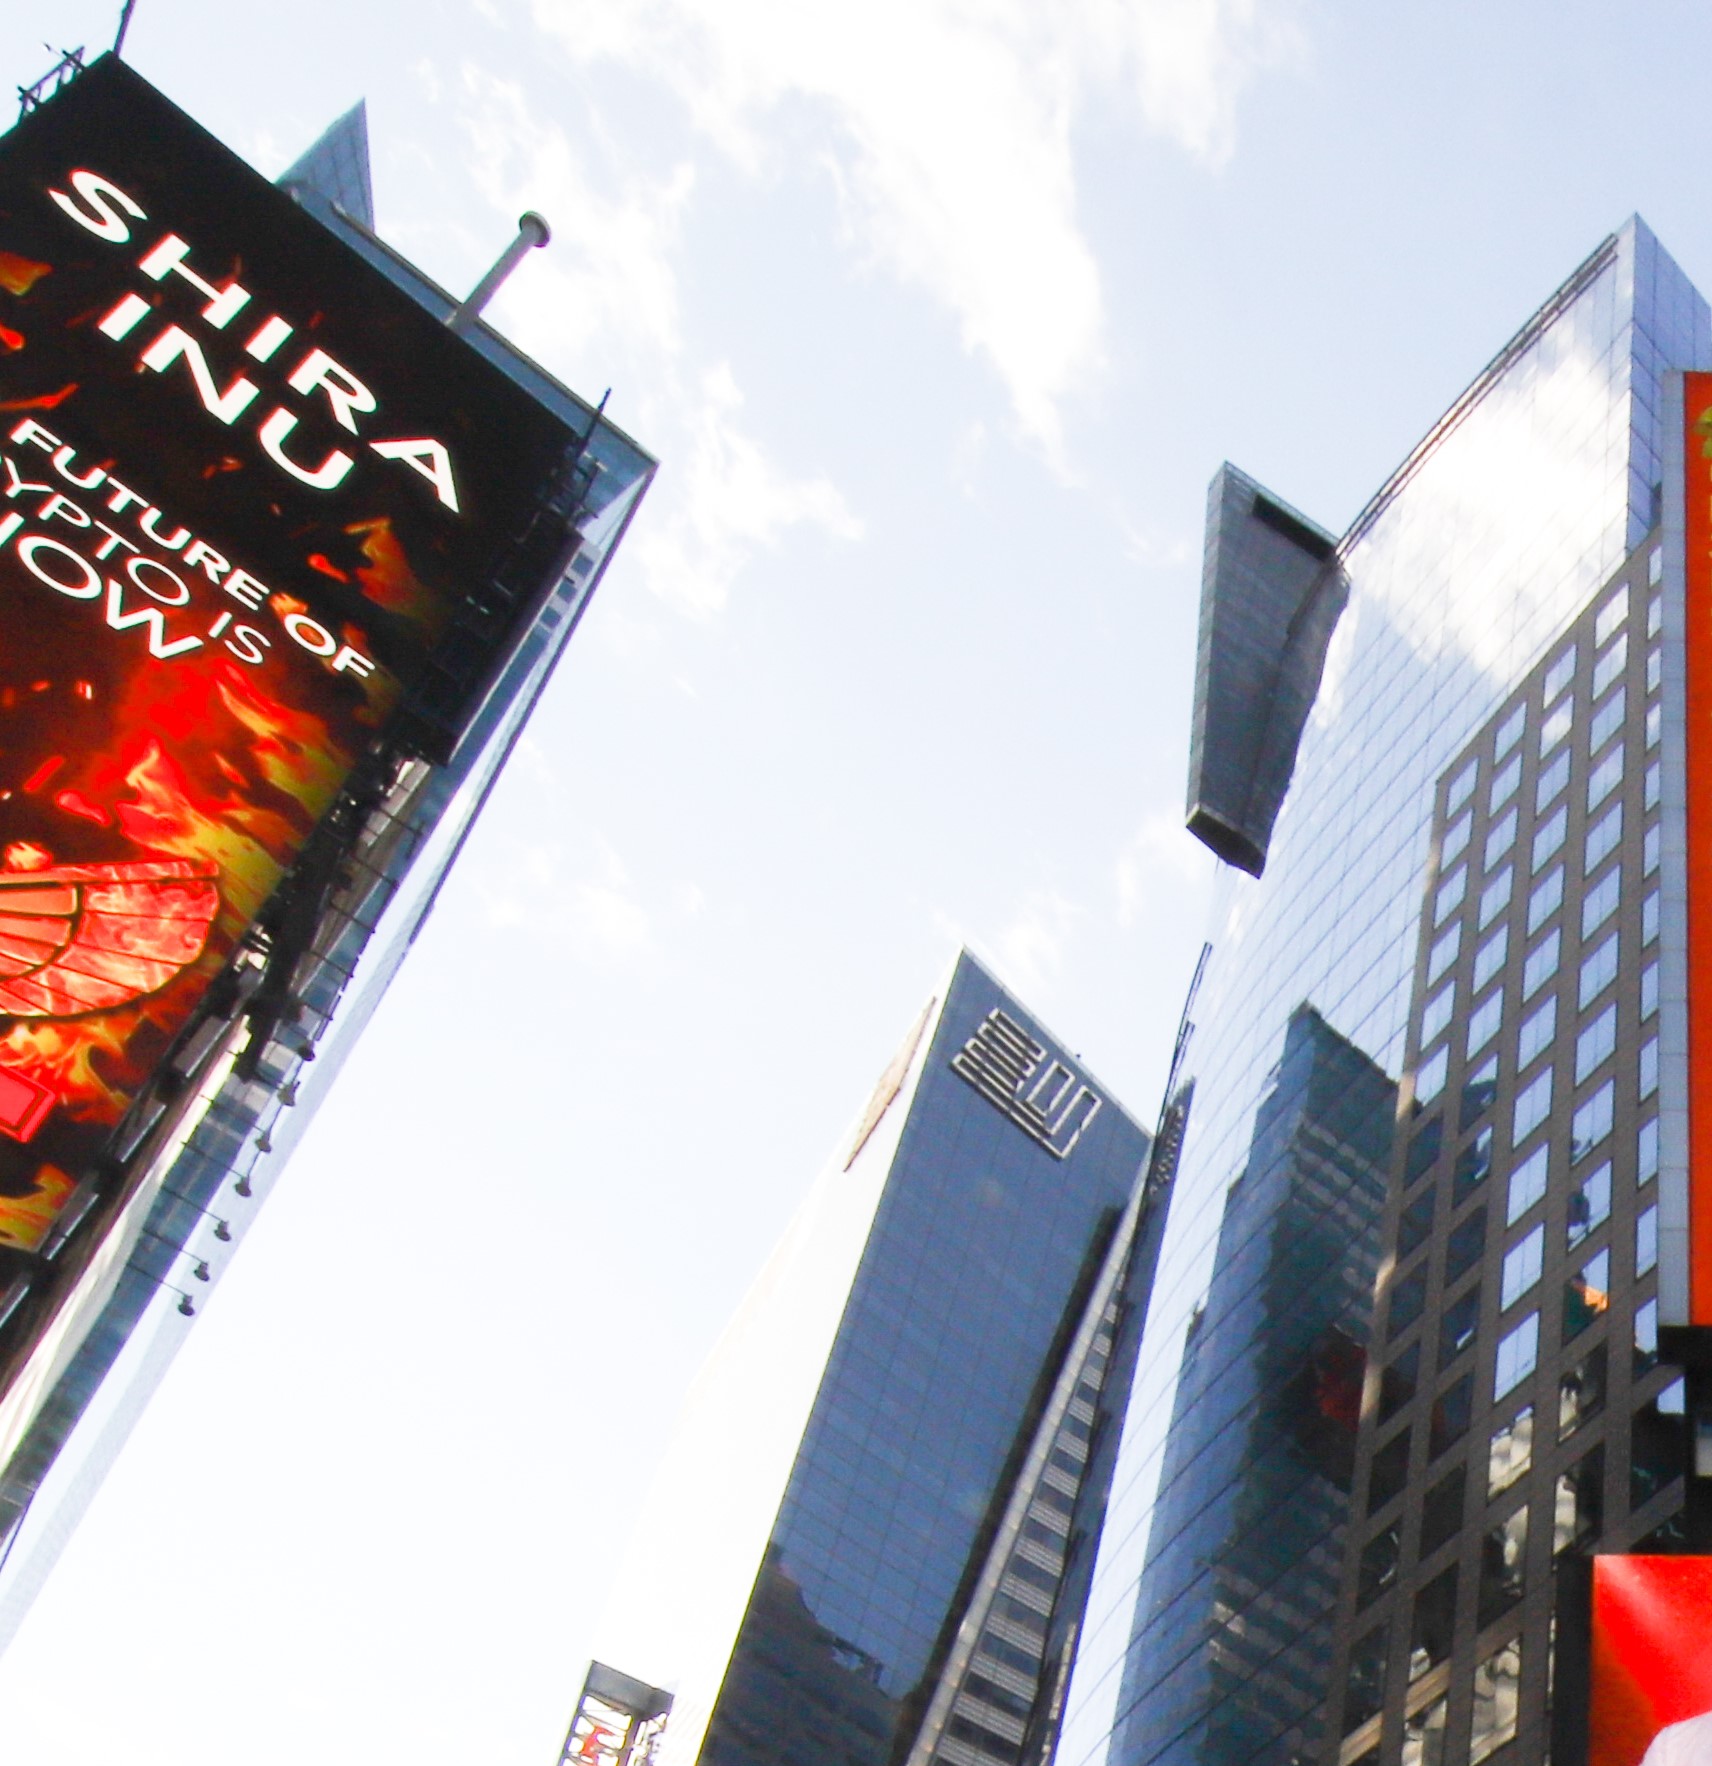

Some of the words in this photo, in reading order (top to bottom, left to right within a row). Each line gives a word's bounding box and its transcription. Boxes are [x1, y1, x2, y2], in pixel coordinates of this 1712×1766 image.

[49, 168, 461, 515] SHIRA
[97, 292, 356, 493] INU
[0, 456, 191, 606] YPTO
[208, 611, 272, 664] IS
[10, 418, 271, 611] FUTURE
[284, 612, 376, 678] OF
